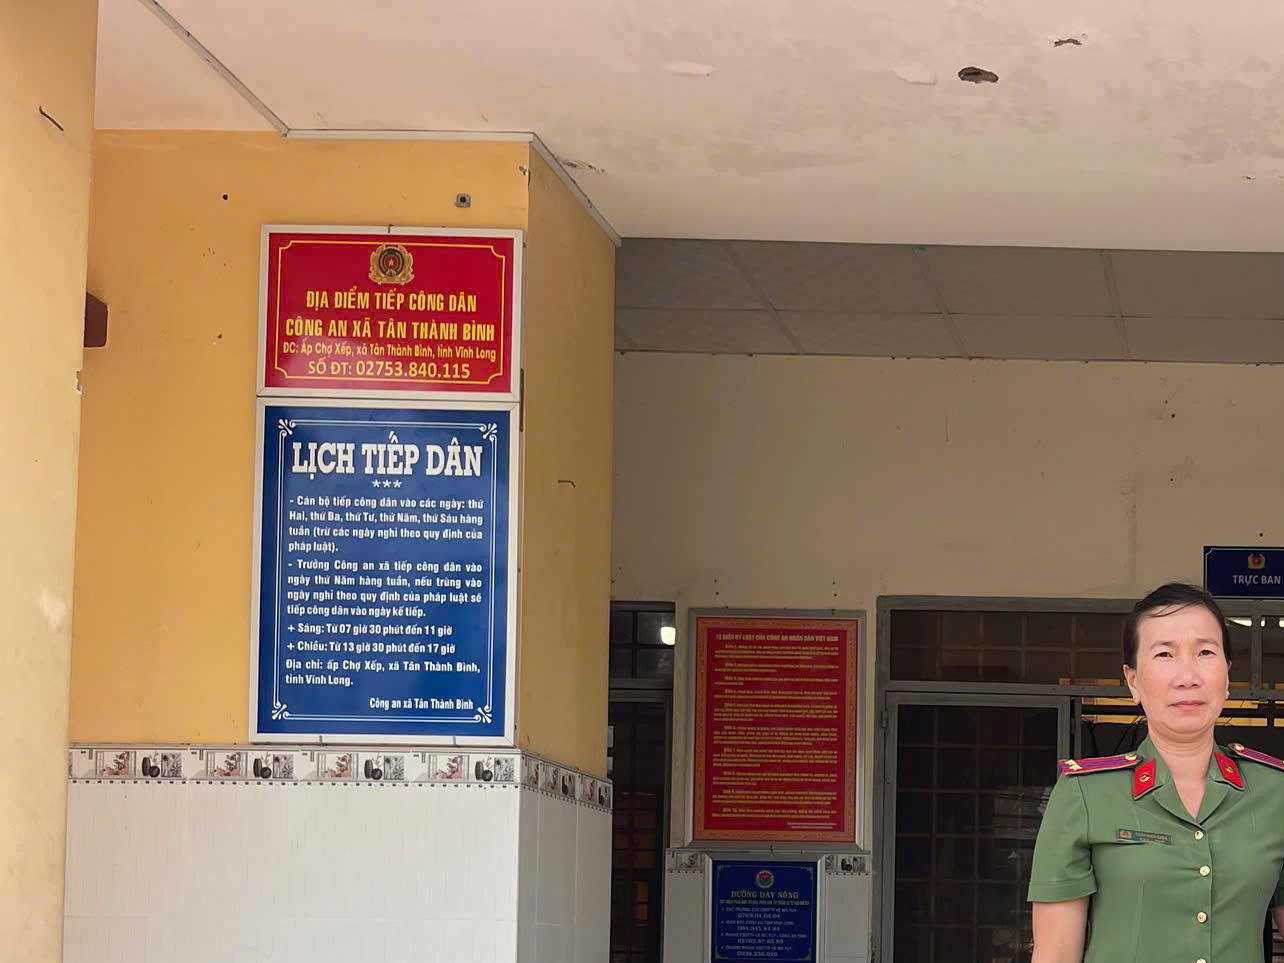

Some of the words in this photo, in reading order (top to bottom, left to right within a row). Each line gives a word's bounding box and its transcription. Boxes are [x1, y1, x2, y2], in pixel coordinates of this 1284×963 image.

[306, 291, 329, 311] ĐỊA
[334, 286, 369, 309] ĐIỂM
[375, 288, 404, 310] TIẾP
[409, 291, 444, 311] CÔNG
[449, 292, 476, 312] DÂN
[286, 316, 323, 338] CÔNG
[328, 320, 347, 337] AN
[352, 317, 371, 337] XÃ
[378, 318, 406, 339] TÂN
[412, 320, 458, 340] THÀNH
[463, 320, 495, 341] BÌNH
[308, 357, 326, 374] SỐ
[330, 362, 352, 375] ĐT:
[356, 361, 470, 379] 02753.840.115
[292, 442, 355, 480] LỊCH
[361, 431, 419, 475] TIẾP
[426, 437, 483, 476] DÂN
[289, 511, 308, 521] Hai,
[328, 511, 343, 522] Ba,
[400, 528, 421, 538] theo
[423, 530, 440, 540] quy
[363, 562, 374, 570] an
[1232, 574, 1259, 586] TRỰC
[1261, 575, 1281, 584] BAN
[339, 624, 352, 633] 07
[369, 624, 381, 634] 30
[424, 625, 435, 635] 11
[343, 642, 355, 652] 13
[372, 642, 384, 652] 30
[427, 643, 439, 653] 17
[328, 675, 353, 687] Long.
[391, 700, 401, 708] an
